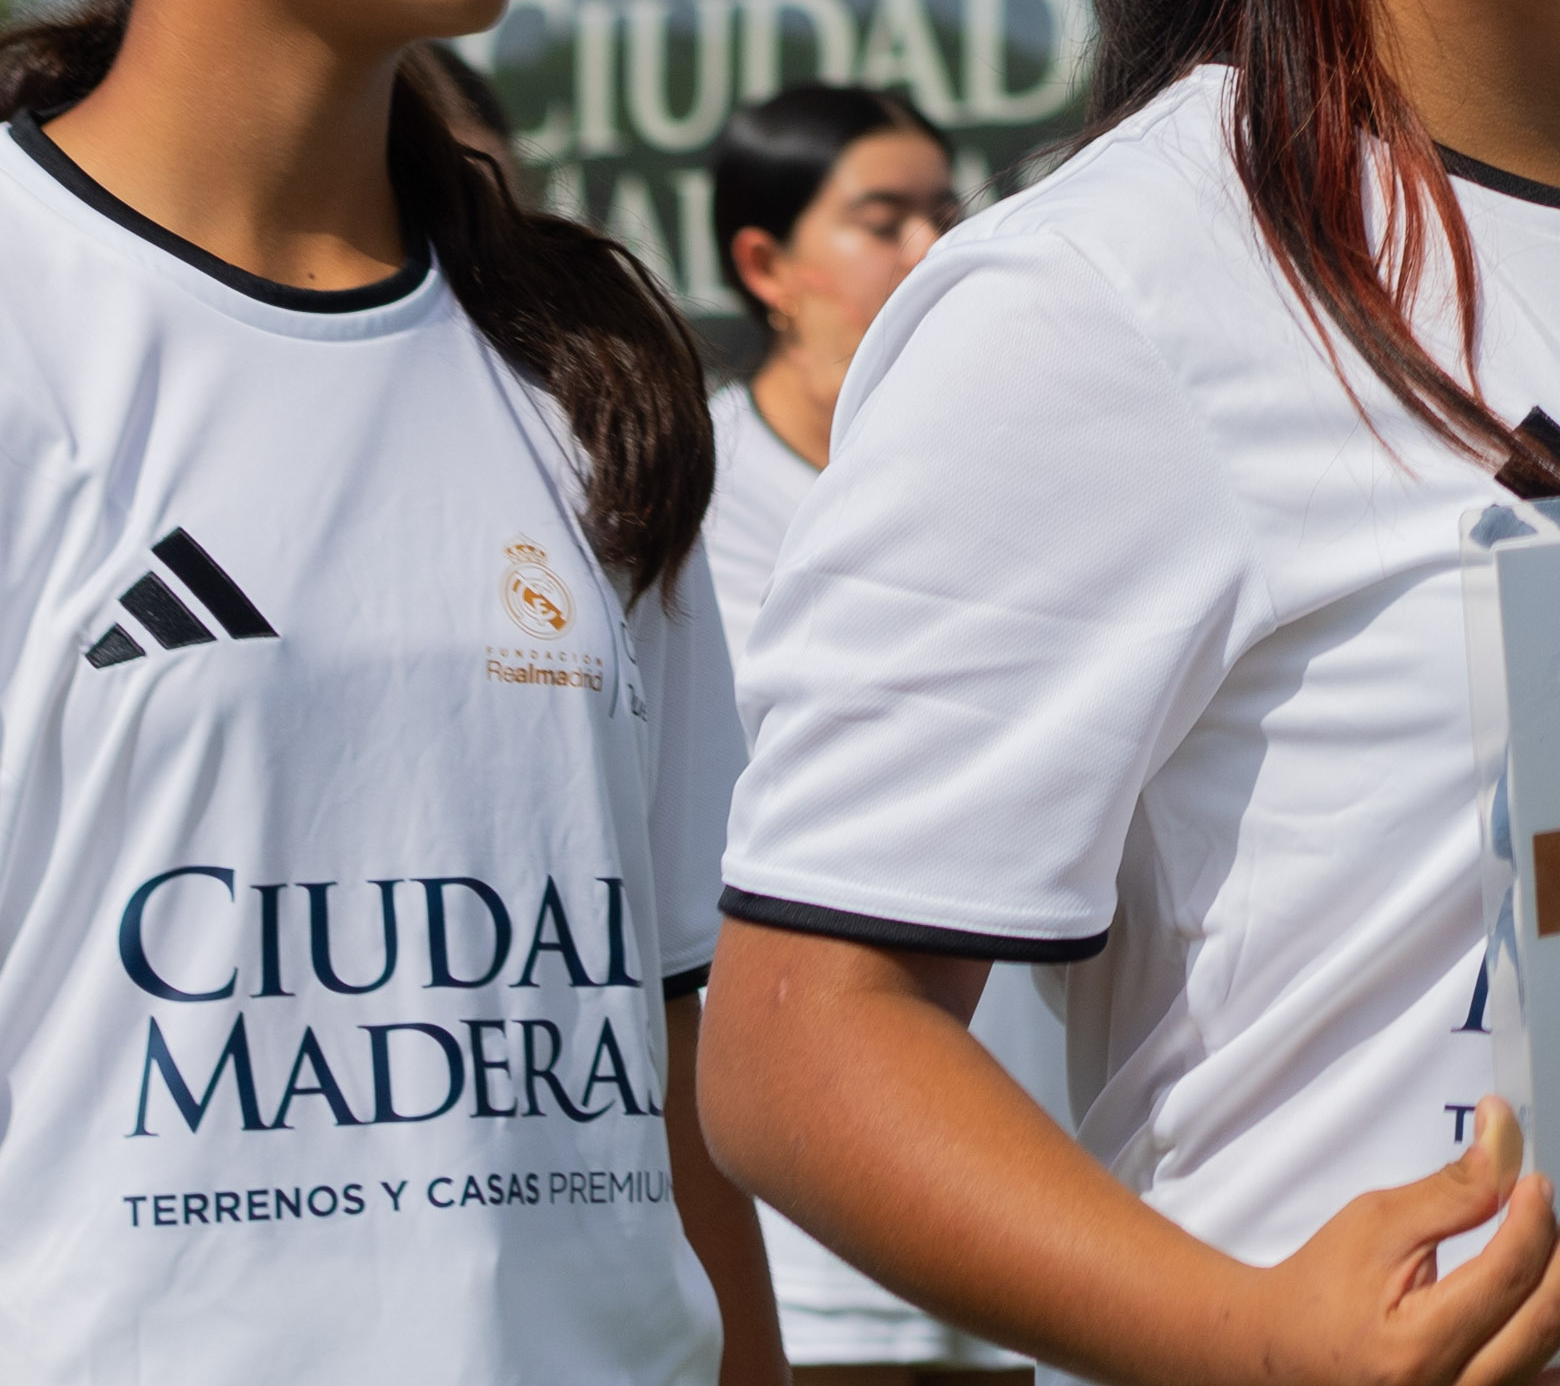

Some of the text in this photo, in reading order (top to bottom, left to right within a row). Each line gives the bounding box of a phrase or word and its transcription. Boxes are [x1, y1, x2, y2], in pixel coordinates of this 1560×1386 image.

[124, 1011, 665, 1138] MADERA
[123, 1170, 675, 1227] TERRENOS Y CASAS PREMIU
